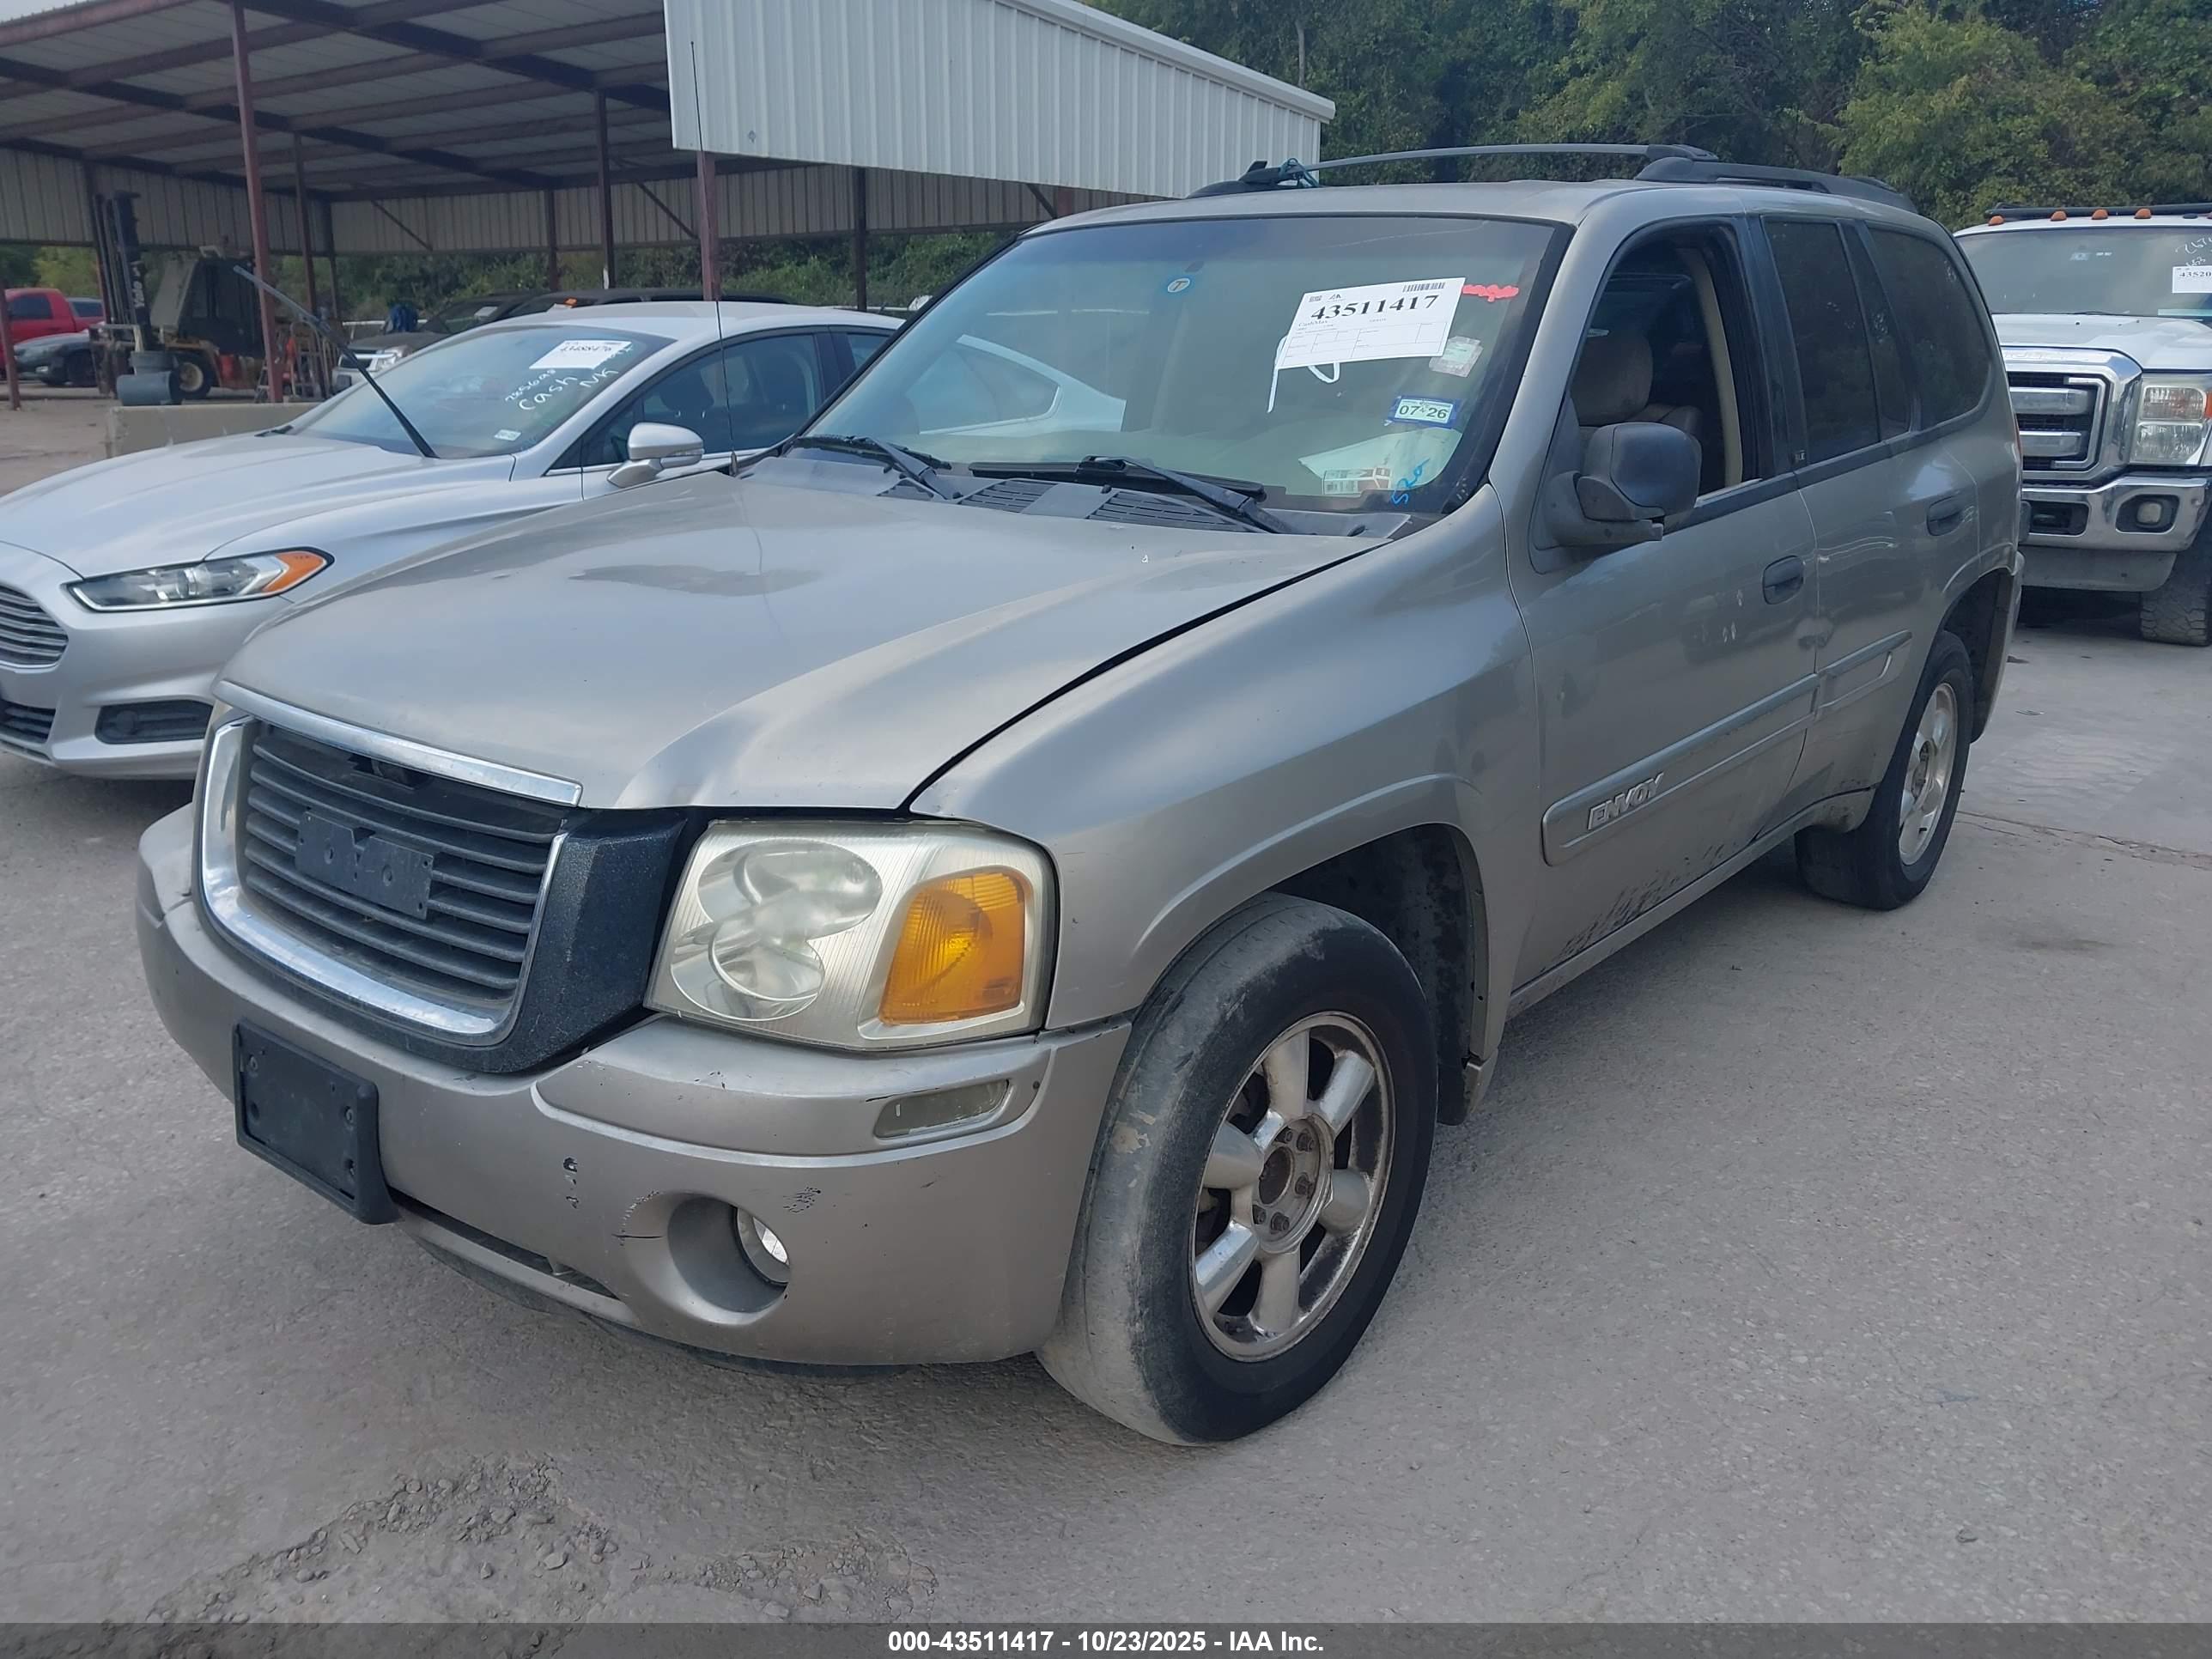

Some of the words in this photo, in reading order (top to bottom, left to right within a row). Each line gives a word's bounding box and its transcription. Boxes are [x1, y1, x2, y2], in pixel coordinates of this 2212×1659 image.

[1310, 295, 1439, 320] 43511417
[519, 377, 578, 410] Cash
[1399, 405, 1419, 416] 07
[1426, 407, 1449, 419] 26
[1587, 772, 1664, 830] ENVOY
